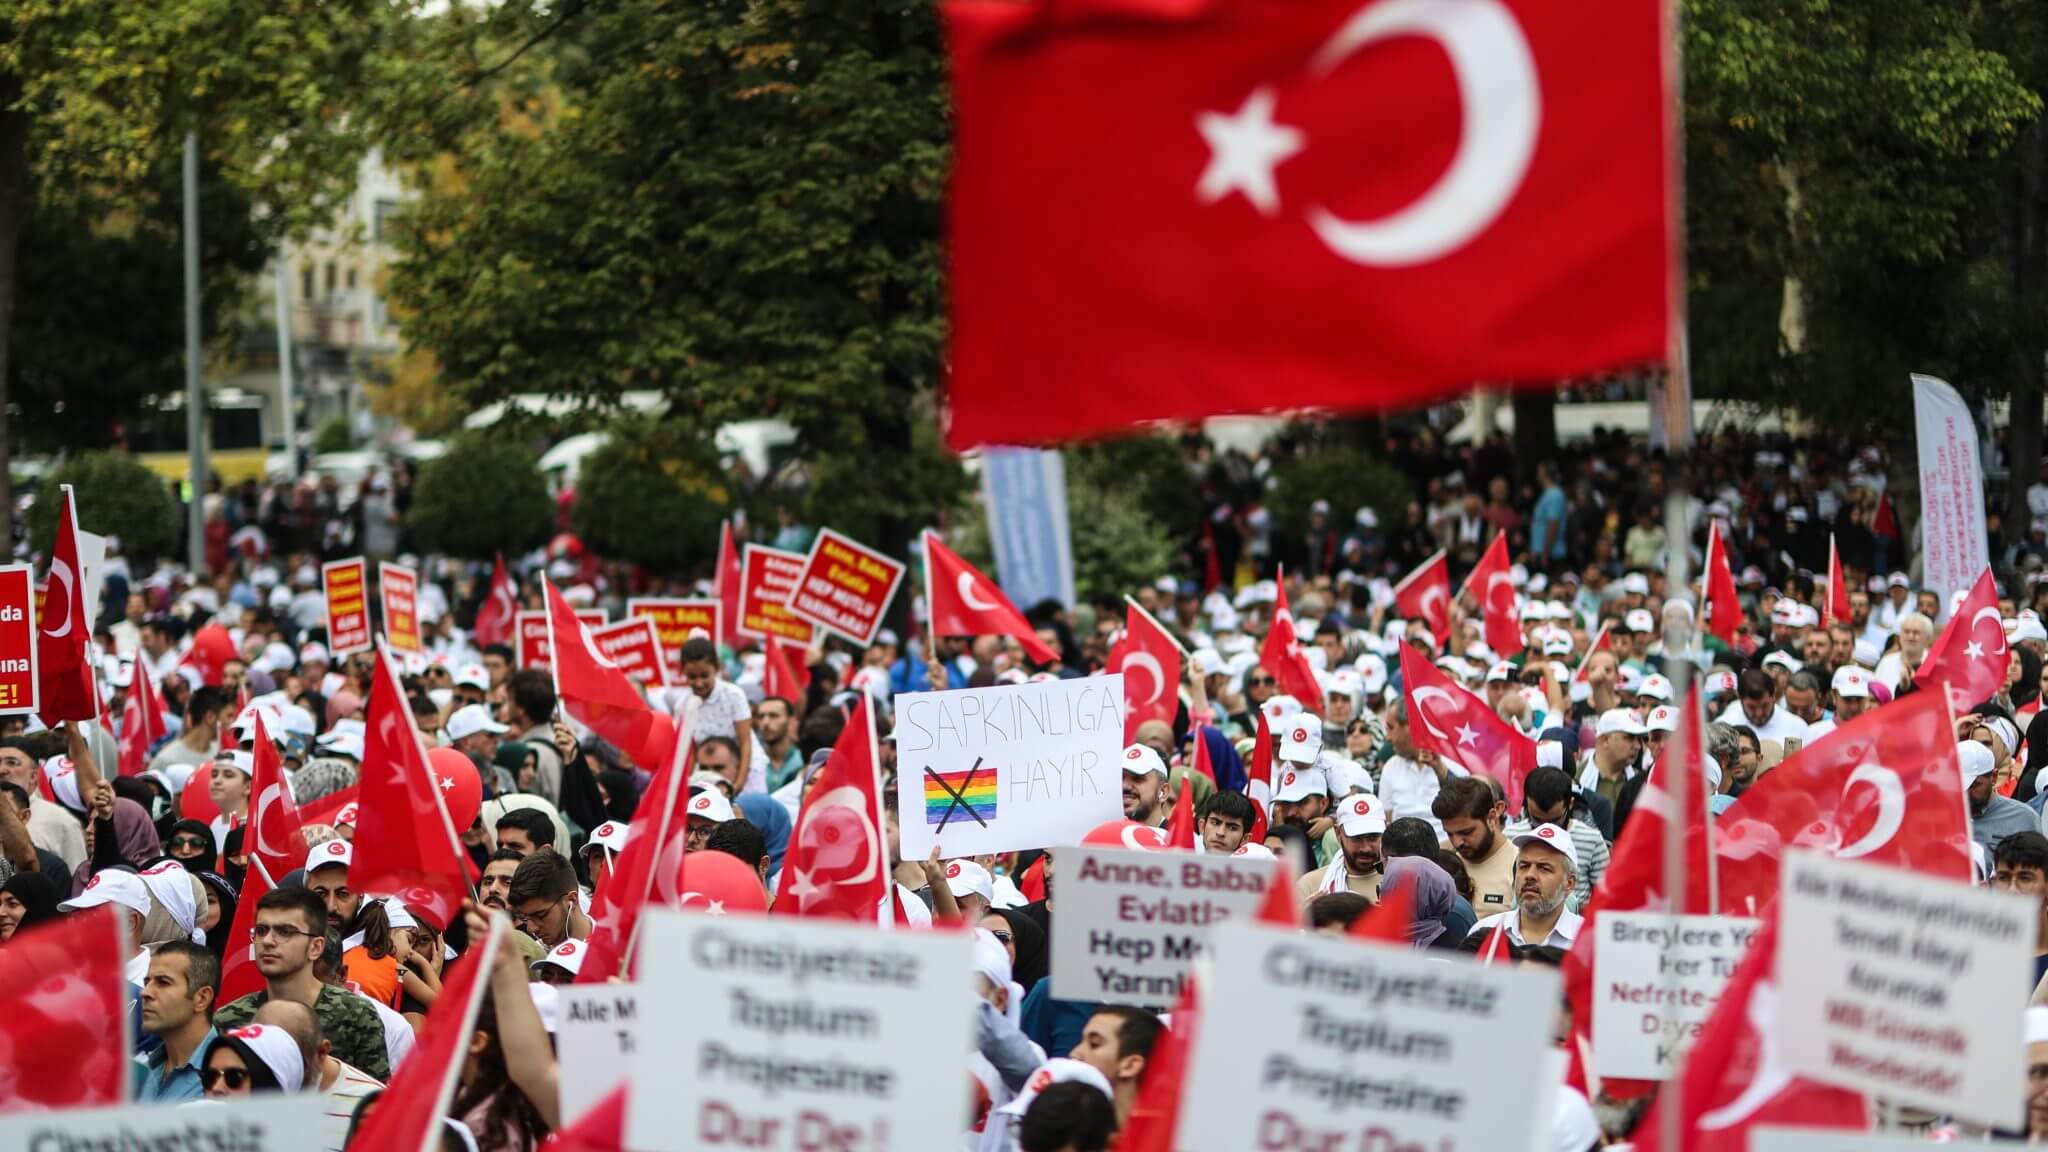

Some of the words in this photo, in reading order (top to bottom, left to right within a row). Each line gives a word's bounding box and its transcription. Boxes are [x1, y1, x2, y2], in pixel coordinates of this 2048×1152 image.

[906, 685, 1122, 752] SAPKINLIĞA
[1009, 751, 1103, 803] HAYIR.
[1078, 856, 1173, 888] Anne,
[690, 927, 921, 986] Cinsiyetsiz
[1089, 930, 1155, 964] Hep
[1611, 921, 1724, 950] Bireylere
[1096, 965, 1186, 997] Yarınl
[1262, 944, 1499, 1018] Cinsiyetsiz
[567, 999, 608, 1023] Aile
[728, 986, 882, 1040] Toplum
[1300, 1004, 1455, 1062] Toplum
[699, 1040, 897, 1099] Projesine
[1259, 1052, 1468, 1121] Projesine
[698, 1098, 781, 1146] Dur
[795, 1110, 866, 1152] De
